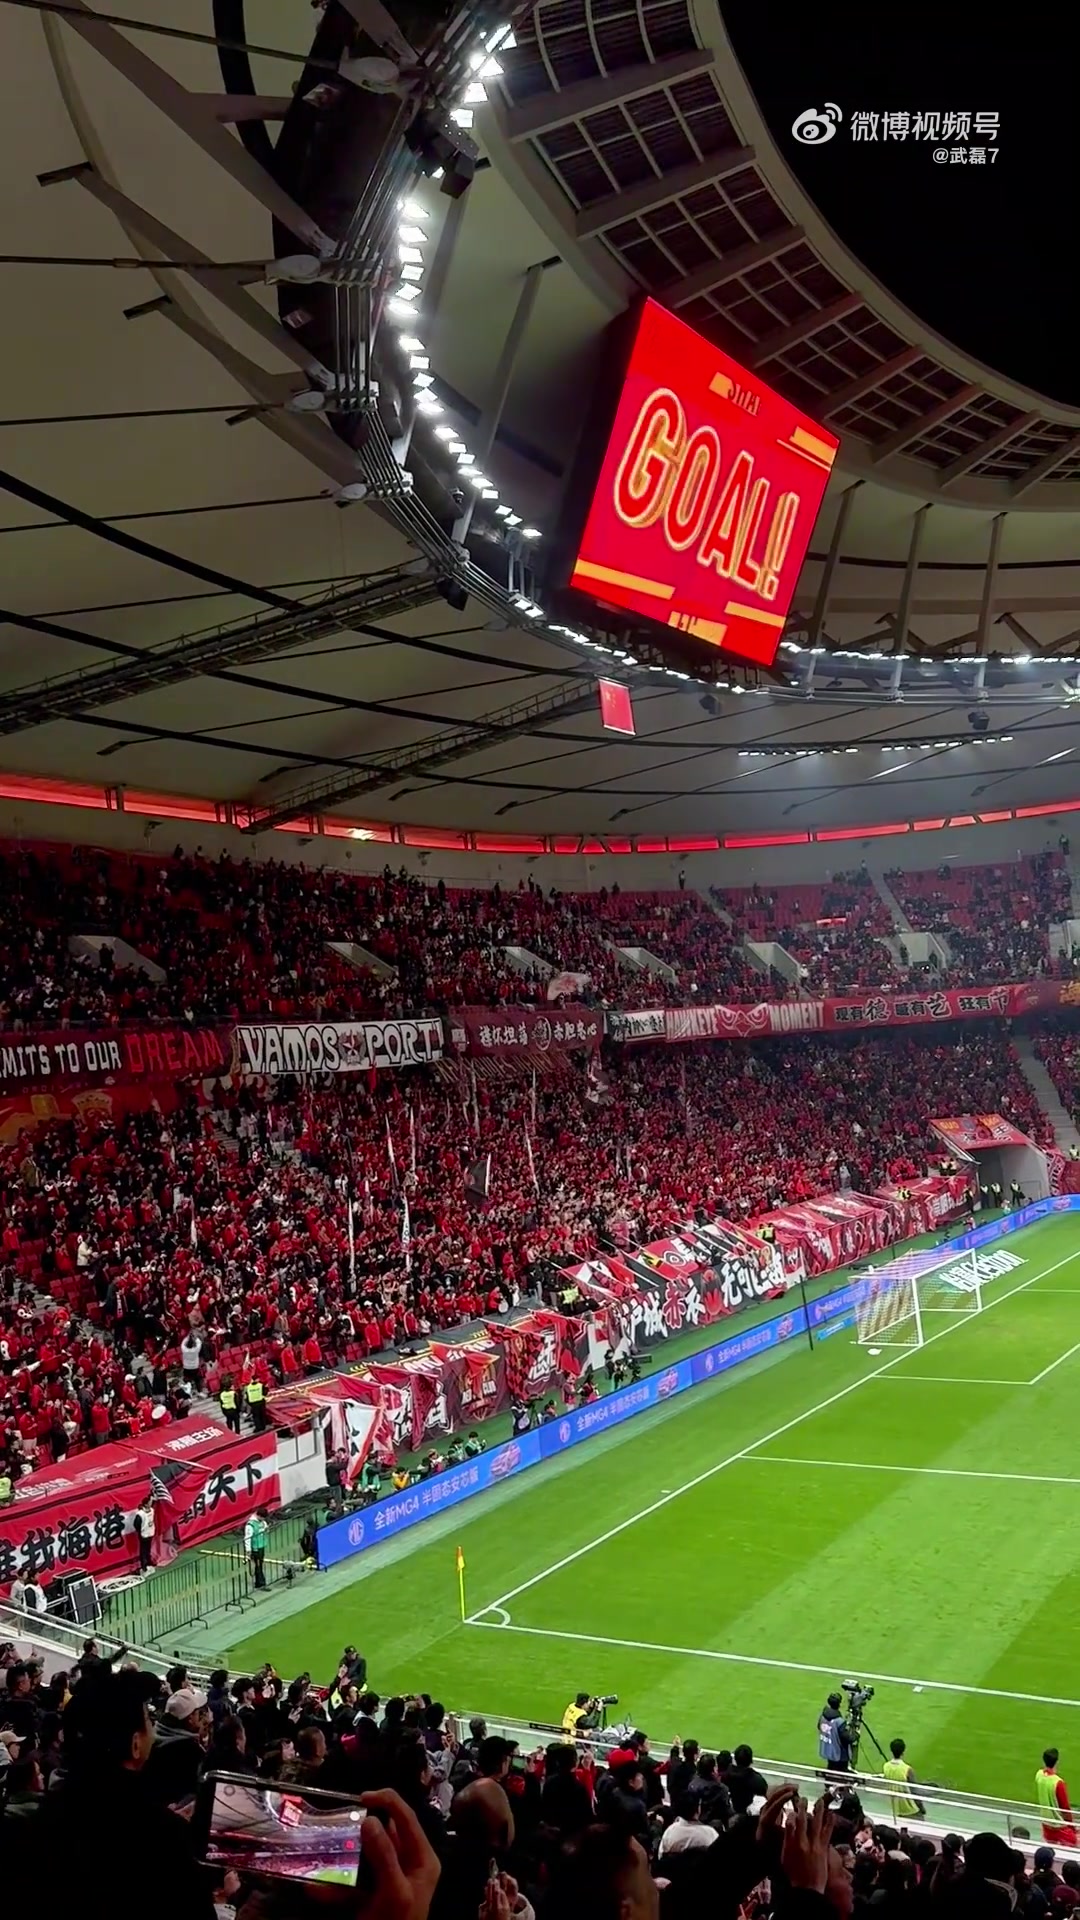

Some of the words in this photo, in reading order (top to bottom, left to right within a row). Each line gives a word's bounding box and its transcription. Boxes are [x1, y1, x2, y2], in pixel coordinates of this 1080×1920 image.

[768, 1000, 825, 1031] MOMENT
[0, 1044, 50, 1078] MITS
[55, 1042, 78, 1074] TO
[84, 1040, 122, 1071] OUR
[125, 1030, 225, 1074] DREAM
[239, 1025, 341, 1075] VAMOS
[363, 1018, 446, 1066] PORT!
[373, 1494, 420, 1531] 全新MG4
[421, 1465, 480, 1506] 半固态安芯版
